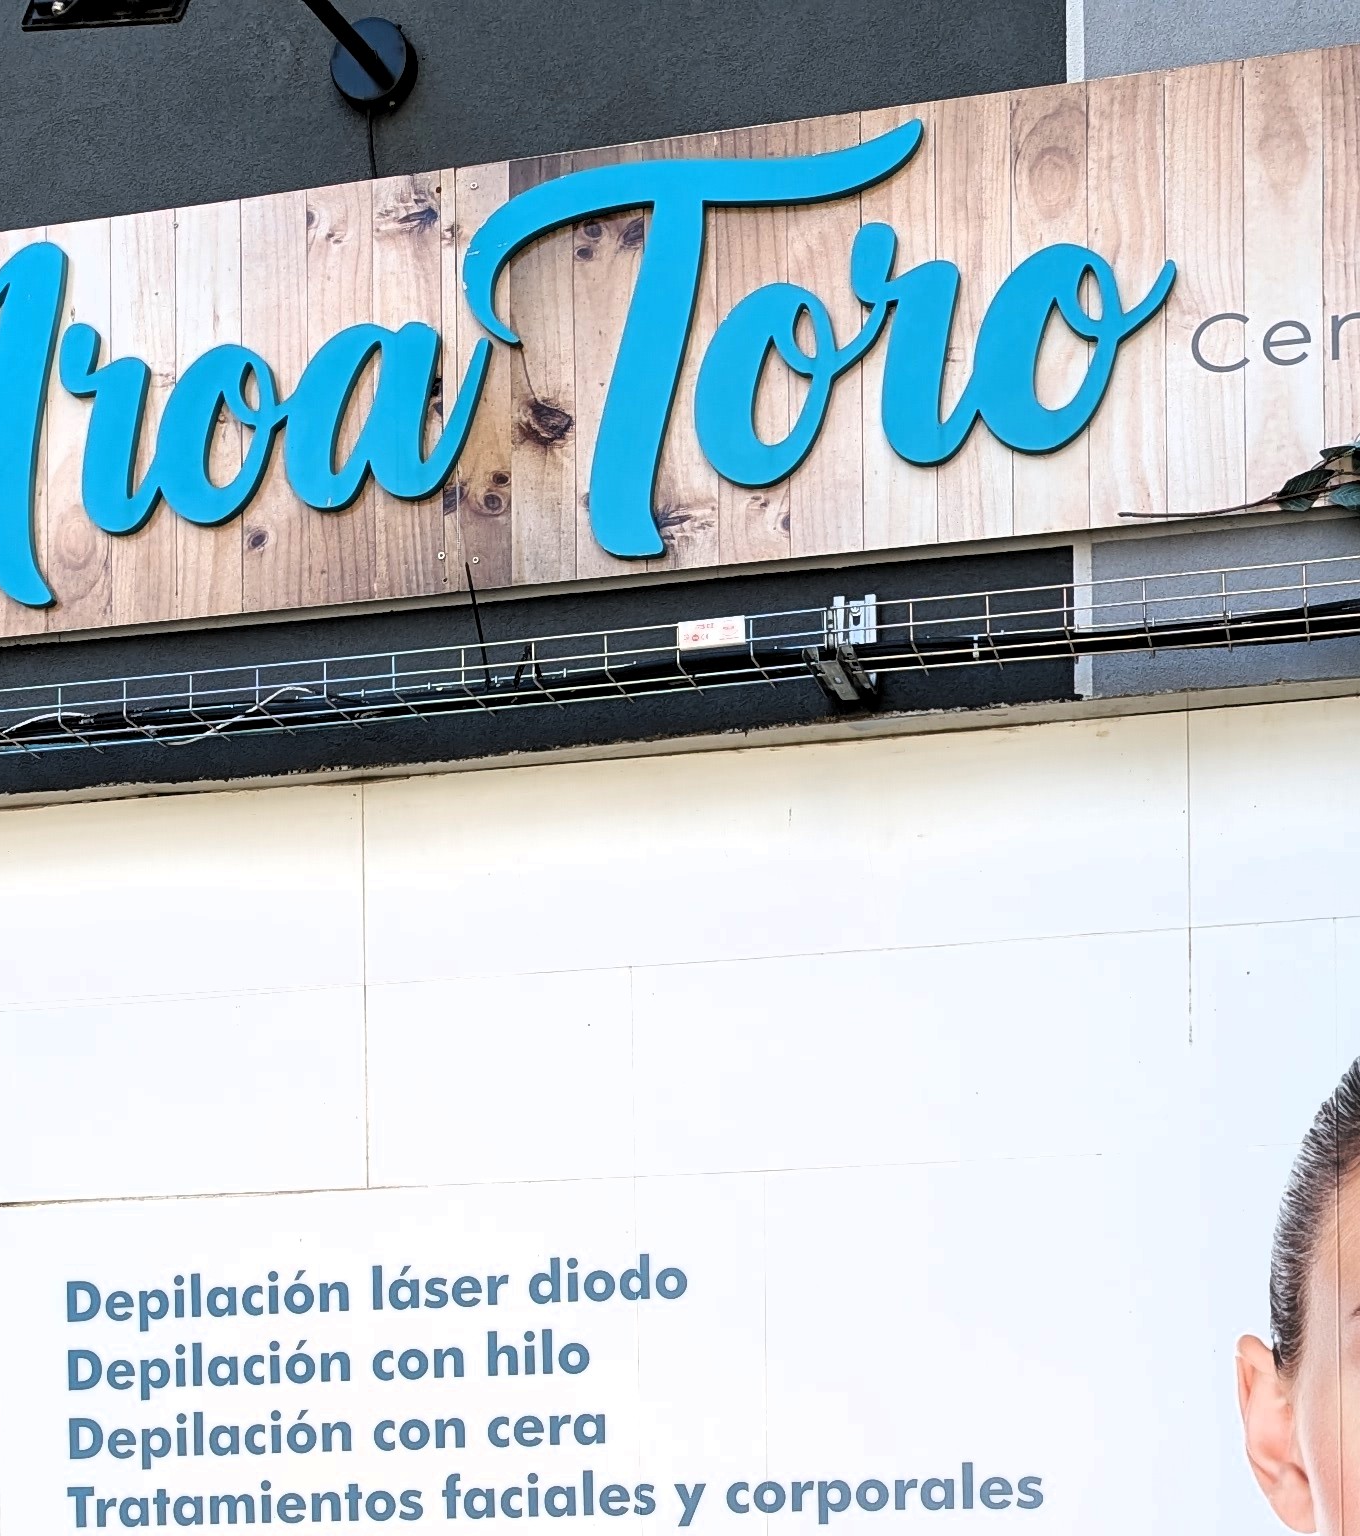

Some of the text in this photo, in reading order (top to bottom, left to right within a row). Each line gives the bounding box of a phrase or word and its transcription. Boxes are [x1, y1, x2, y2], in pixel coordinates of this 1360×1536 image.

[462, 118, 1177, 559] Toro
[66, 1253, 688, 1332] Depilación láser diodo
[67, 1328, 590, 1401] Depilación con hilo
[68, 1410, 606, 1470] Depilación con cera
[67, 1462, 1044, 1528] Tratamientos faciales y corporales
